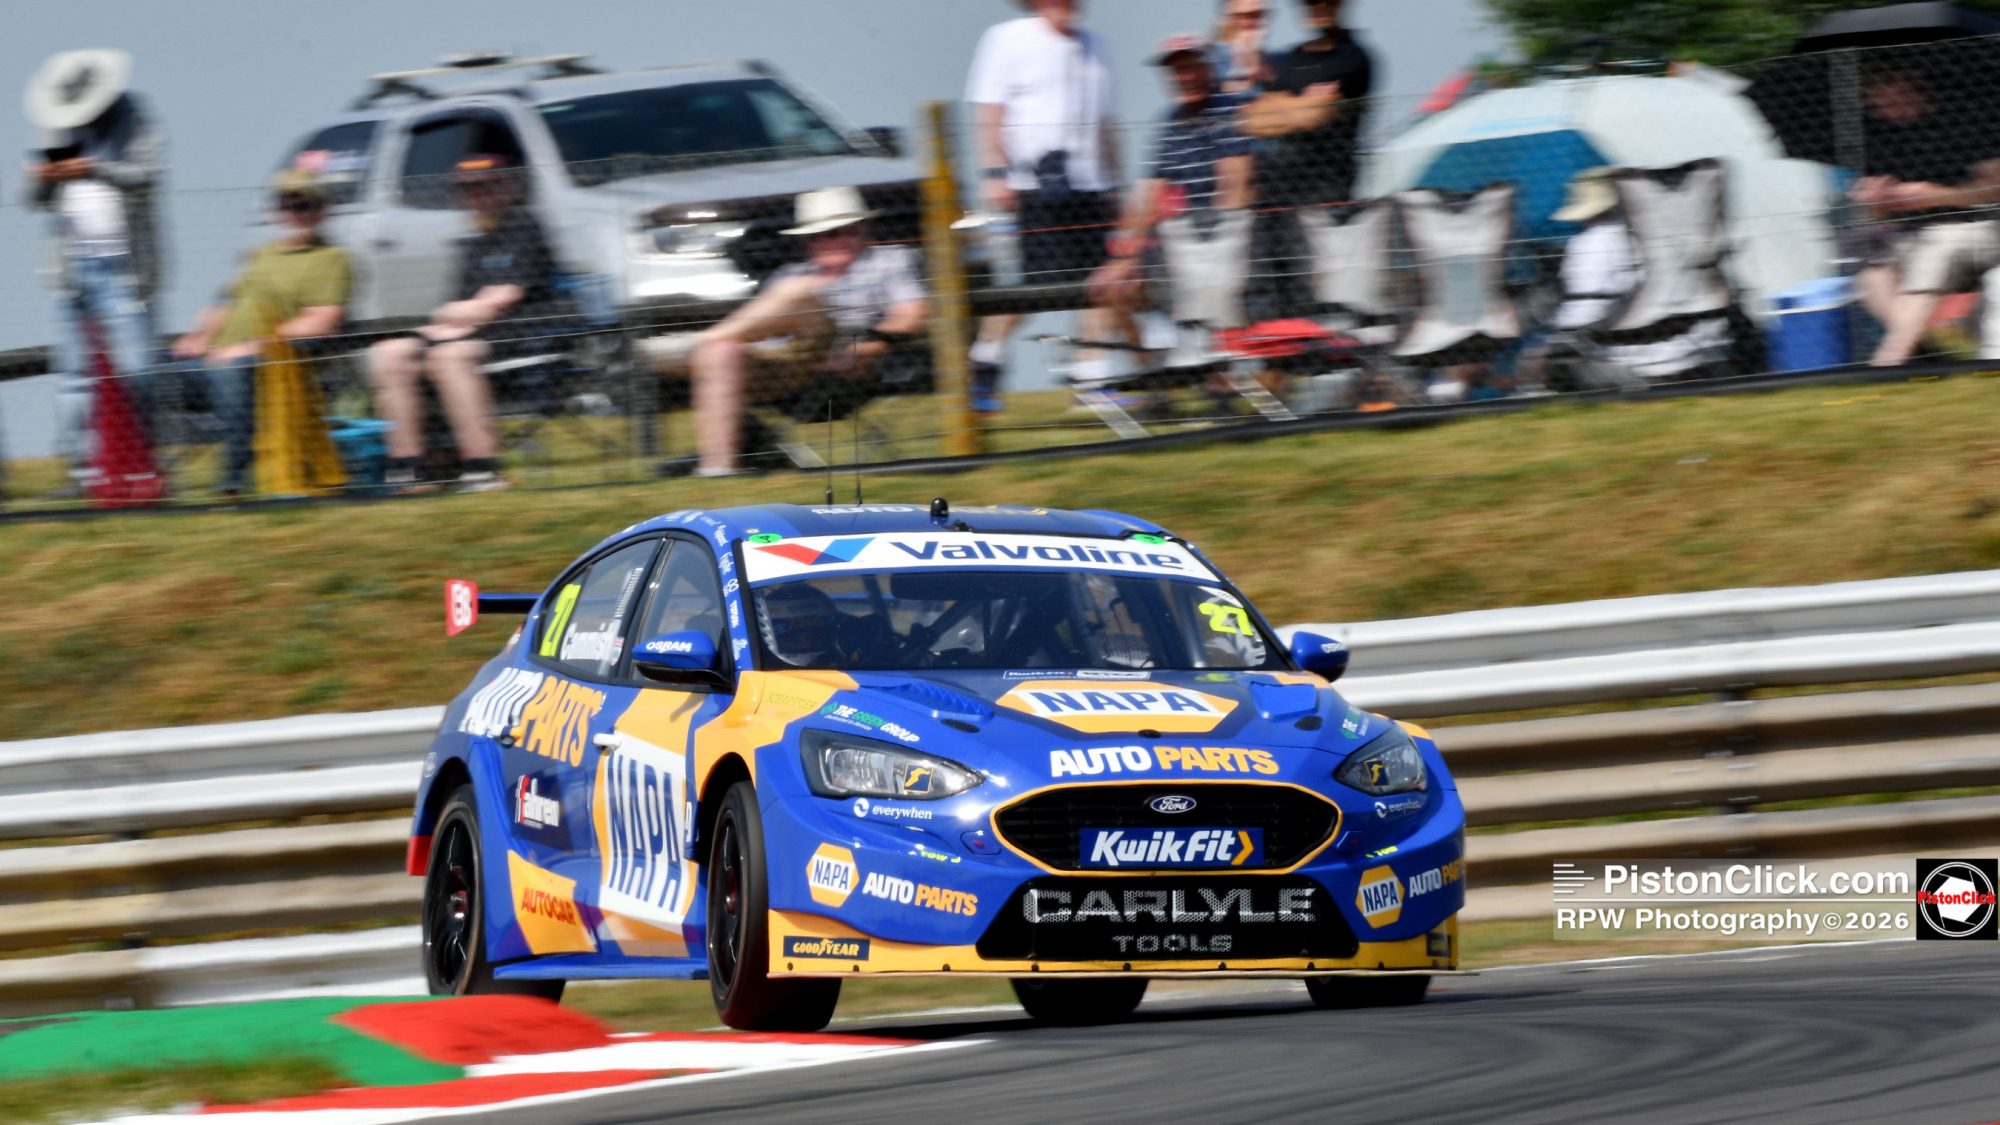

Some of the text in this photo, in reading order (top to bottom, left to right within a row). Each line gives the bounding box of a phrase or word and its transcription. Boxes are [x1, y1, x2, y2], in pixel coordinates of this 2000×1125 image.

[891, 540, 1183, 570] Valvoline
[1199, 602, 1254, 636] 27
[646, 640, 692, 653] OSRAM
[459, 667, 603, 768] AUTO PARTS
[1029, 691, 1212, 713] NAPA
[880, 722, 920, 742] GROUP
[1049, 745, 1280, 777] AUTO PARTS
[872, 805, 932, 821] everywhen
[1157, 799, 1189, 811] Ford
[604, 755, 685, 913] NAPA
[812, 858, 850, 890] NAPA
[1409, 867, 1442, 898] AUTO
[520, 886, 576, 926] AUTOCAR
[862, 872, 978, 916] AUTO PARTS
[1023, 888, 1316, 923] CARLYLE
[1363, 880, 1399, 913] NAPA
[793, 939, 860, 956] GOODYEAR
[1113, 934, 1232, 952] TOOLS
